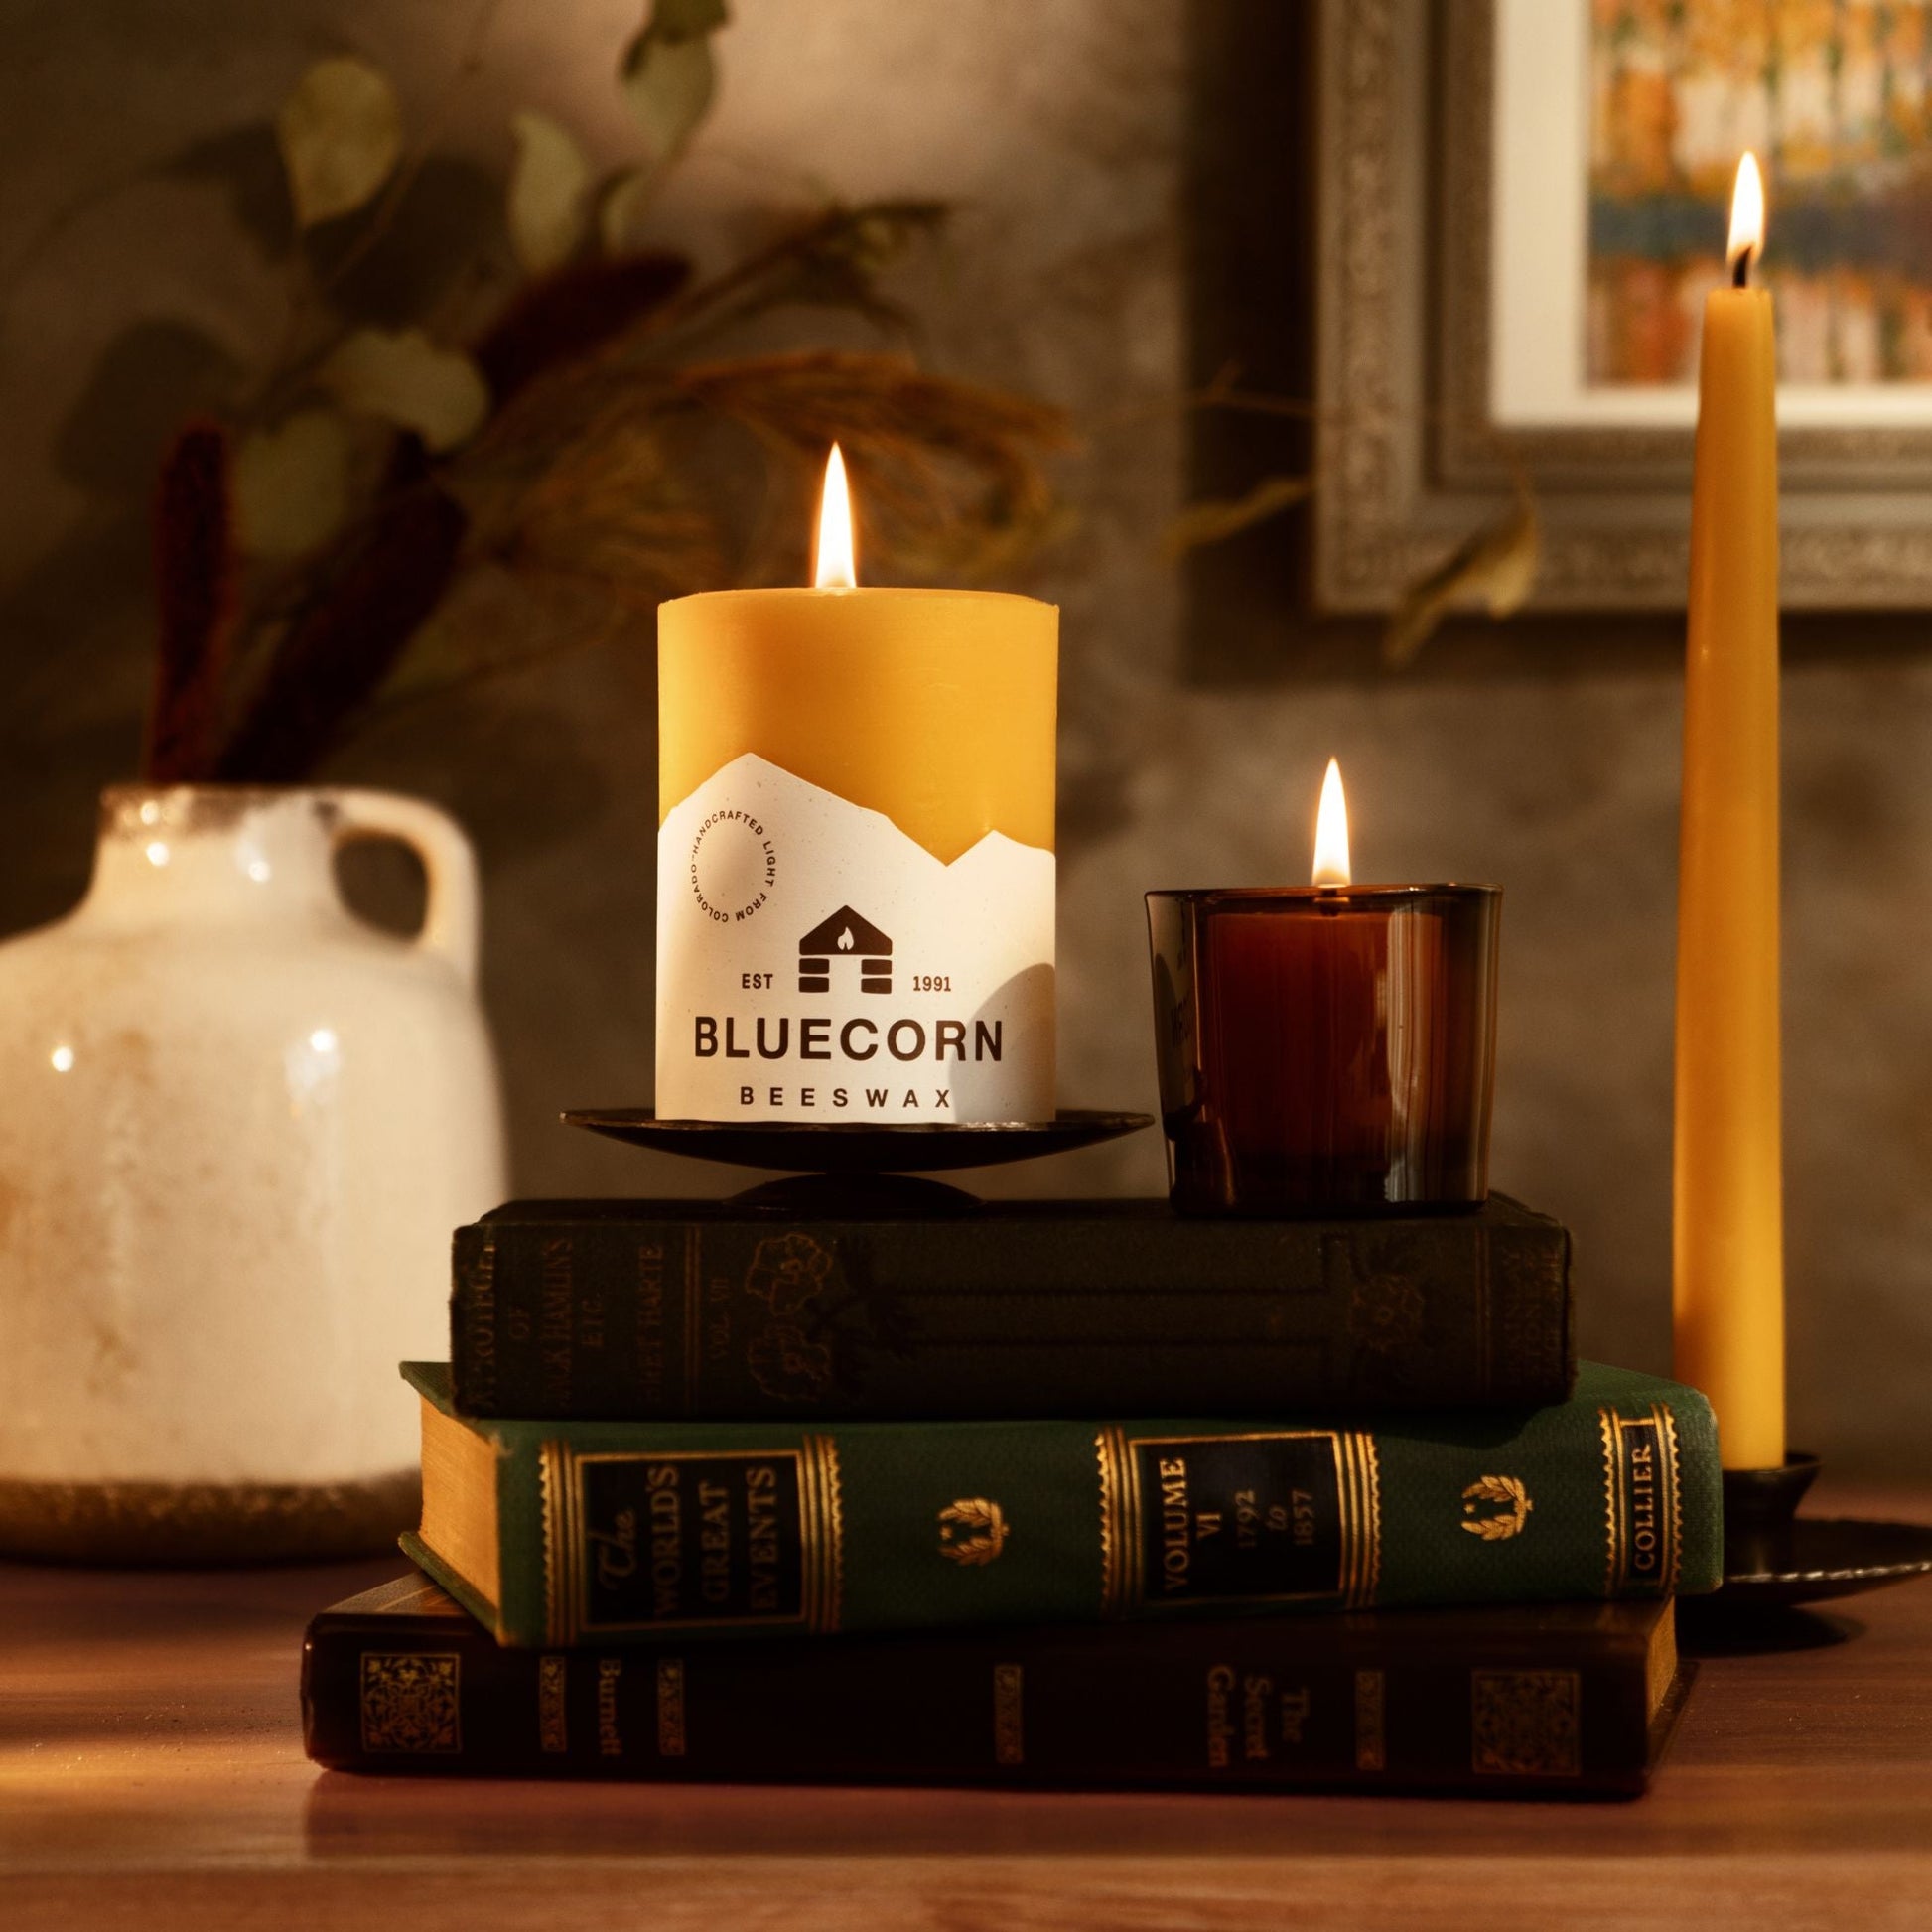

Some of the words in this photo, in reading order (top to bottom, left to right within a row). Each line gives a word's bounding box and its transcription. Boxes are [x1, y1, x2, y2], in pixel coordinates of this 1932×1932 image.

[693, 810, 763, 854] HANDCRAFTED
[691, 864, 729, 922] COLORADO
[763, 841, 776, 887] LIGHT
[735, 893, 767, 921] FROM
[742, 974, 773, 989] EST
[912, 976, 952, 992] 1991
[694, 1016, 1003, 1061] BLUECORN
[740, 1086, 950, 1108] BEESWAX
[1159, 1457, 1189, 1591] VOLUME
[1195, 1510, 1222, 1540] VI
[1234, 1489, 1259, 1549] 1792
[1264, 1505, 1288, 1532] to
[1291, 1488, 1315, 1547] 1857
[1631, 1444, 1656, 1571] COLLIER
[586, 1509, 637, 1590] The
[646, 1465, 682, 1616] WORLD'S
[699, 1480, 731, 1603] GREAT
[746, 1466, 778, 1609] EVENTS
[598, 1657, 624, 1755] Burnett
